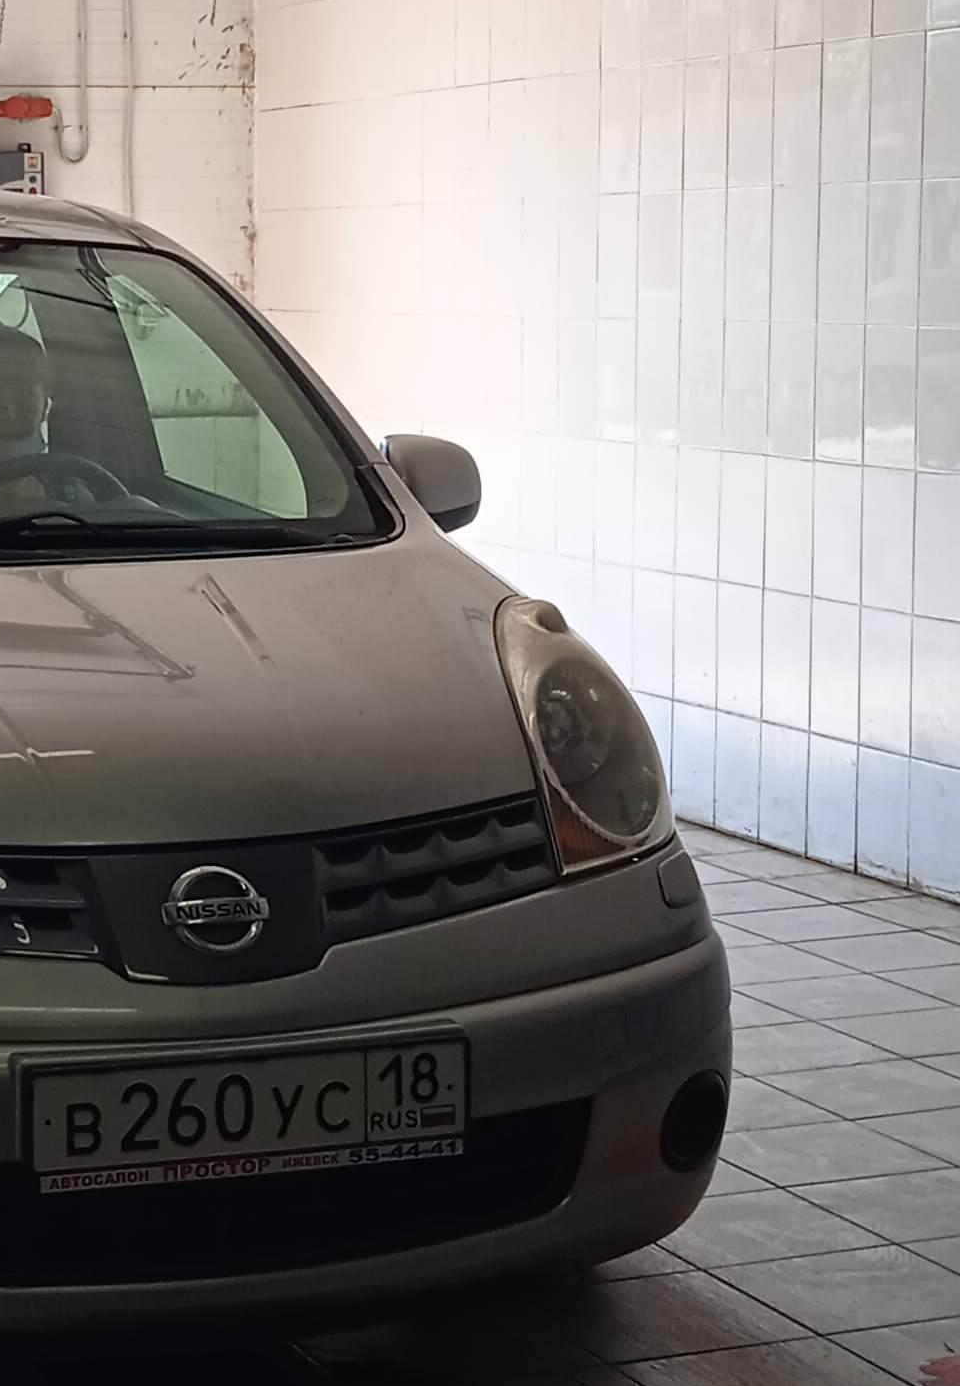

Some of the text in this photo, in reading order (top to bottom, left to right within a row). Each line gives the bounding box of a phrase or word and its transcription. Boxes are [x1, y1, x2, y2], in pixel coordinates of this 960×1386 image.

[176, 901, 262, 920] NISSAN
[378, 1053, 439, 1106] 18
[370, 1110, 420, 1133] RUS
[48, 1169, 151, 1191] АВТОСАЛОН
[162, 1158, 270, 1181] ПРОСТОР
[282, 1154, 339, 1169] ИЖЕВСК
